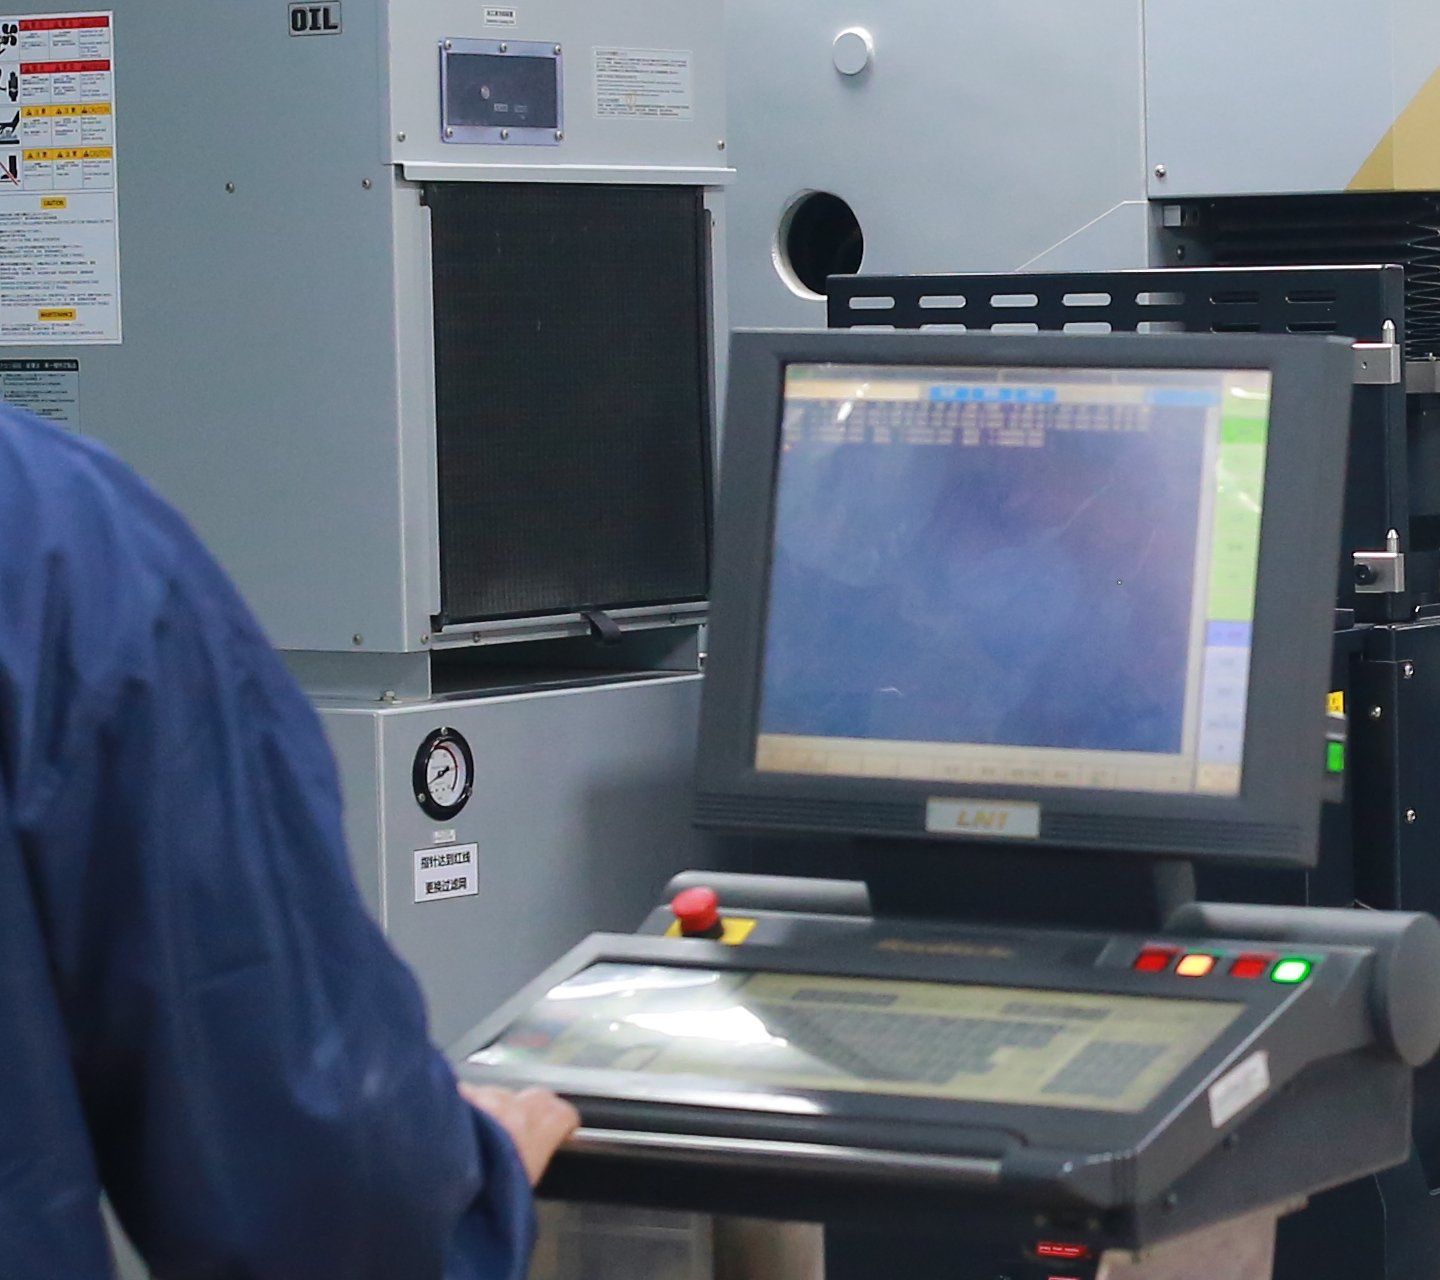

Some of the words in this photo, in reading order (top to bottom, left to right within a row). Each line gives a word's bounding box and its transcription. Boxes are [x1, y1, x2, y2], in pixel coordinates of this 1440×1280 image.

[290, 6, 339, 32] OIL
[420, 851, 472, 870] 指针达到红线
[425, 876, 467, 895] 更换过滤网
